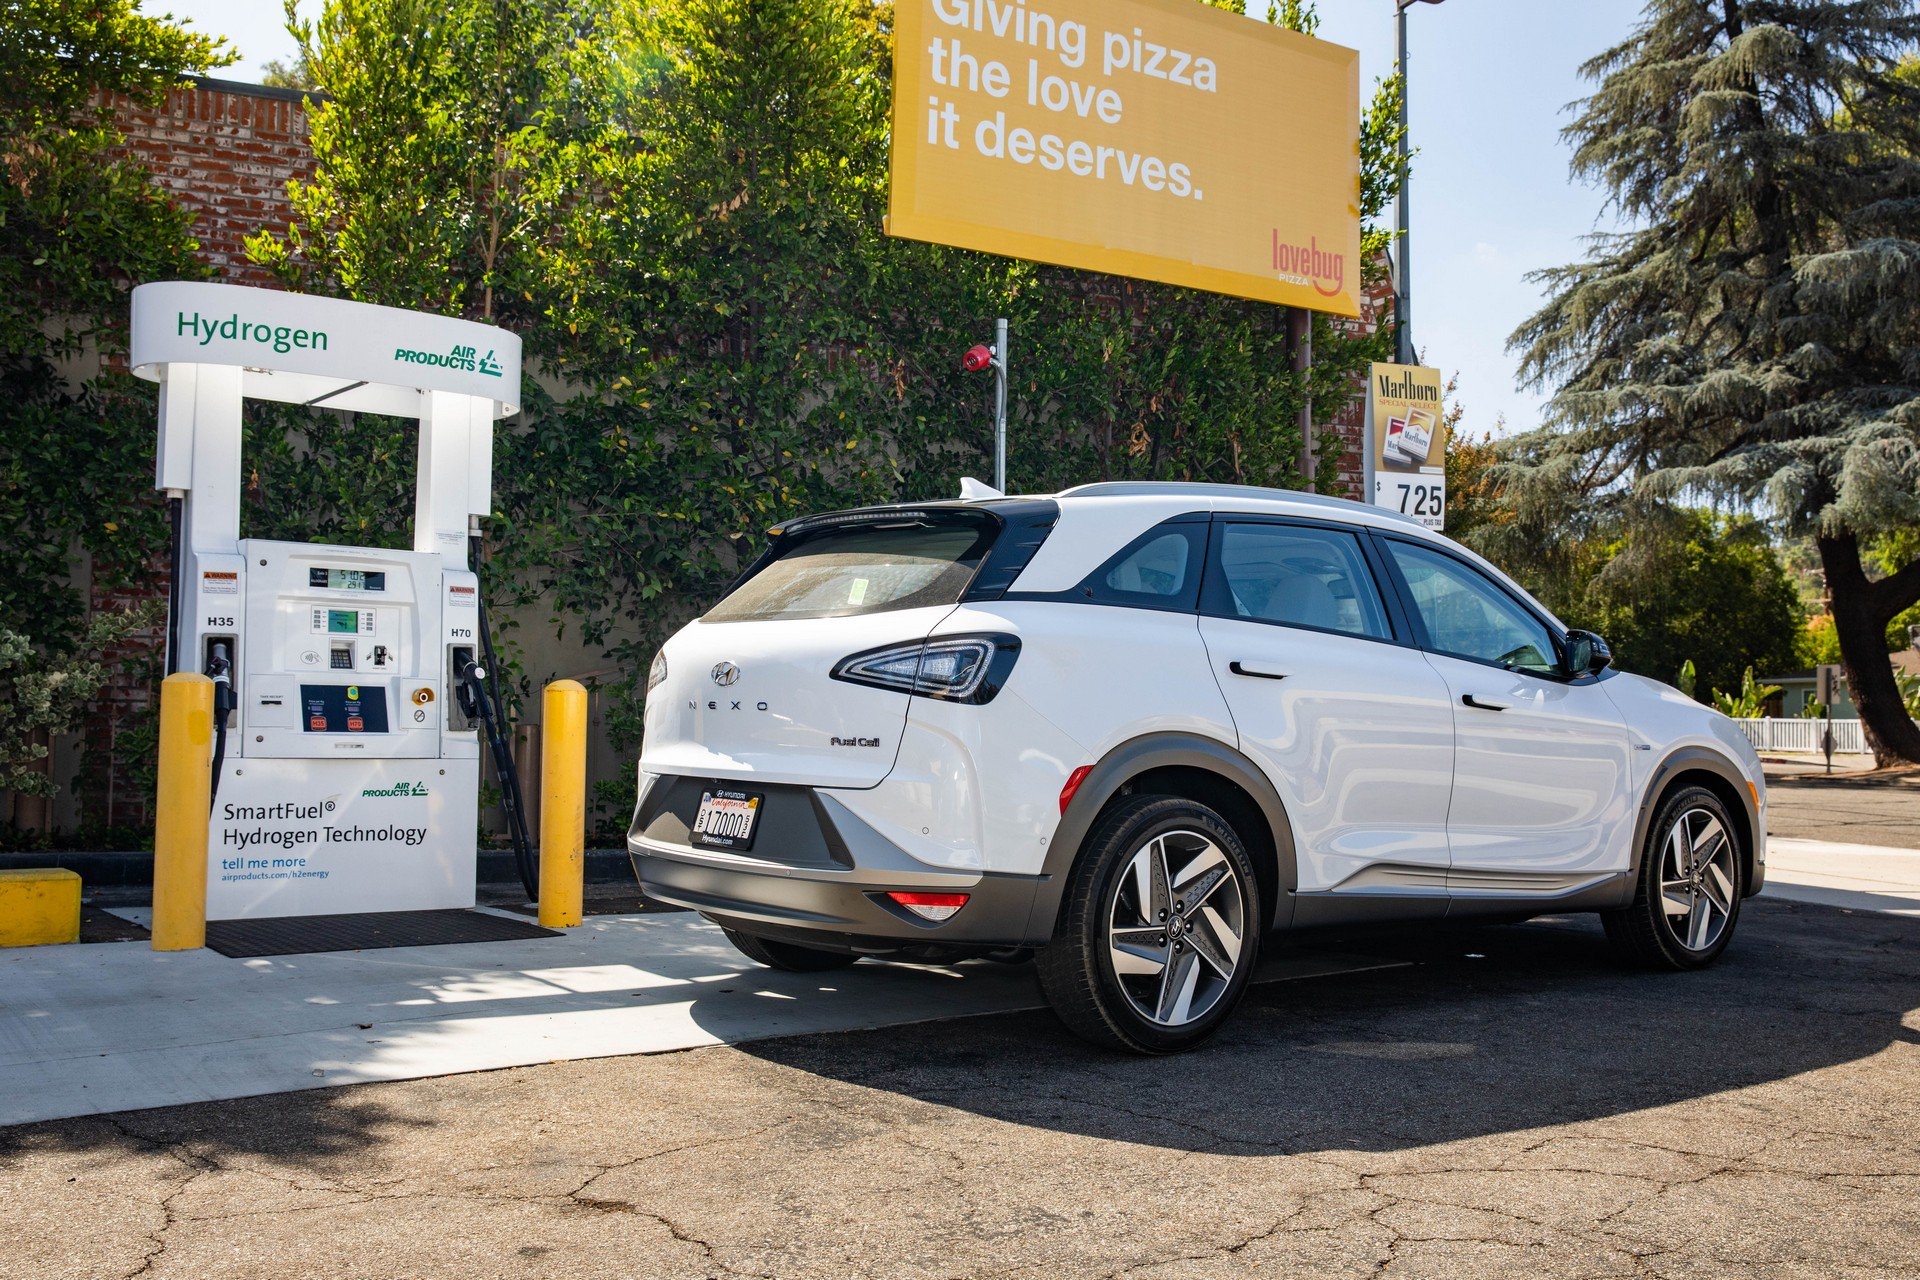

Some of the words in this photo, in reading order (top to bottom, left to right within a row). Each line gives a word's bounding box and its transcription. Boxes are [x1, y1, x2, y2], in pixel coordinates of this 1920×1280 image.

[1103, 27, 1217, 93] pizza
[928, 37, 1011, 98] the
[1028, 59, 1123, 124] love
[928, 96, 960, 149] it
[975, 111, 1203, 200] deserves.
[1273, 228, 1343, 297] lovebug
[1279, 274, 1309, 286] PIZZA
[178, 312, 328, 353] Hydrogen
[451, 345, 476, 359] AIR
[394, 348, 476, 371] PRODUCTS
[1379, 371, 1437, 402] Marlboro
[1376, 481, 1381, 491] $
[207, 617, 234, 627] H35
[451, 628, 471, 638] H70
[688, 700, 768, 712] NEXO
[830, 737, 857, 747] Fuel
[858, 738, 880, 748] Cell
[394, 782, 410, 790] AIR
[362, 789, 410, 797] PRODUCTS
[724, 791, 746, 799] HYUNDAI
[705, 810, 743, 837] 17000
[223, 827, 318, 850] Hydrogen
[323, 824, 427, 846] Technology
[222, 857, 244, 870] tell
[247, 859, 268, 868] me
[272, 857, 306, 867] more
[221, 869, 330, 882] airproducts.com/h2energy
